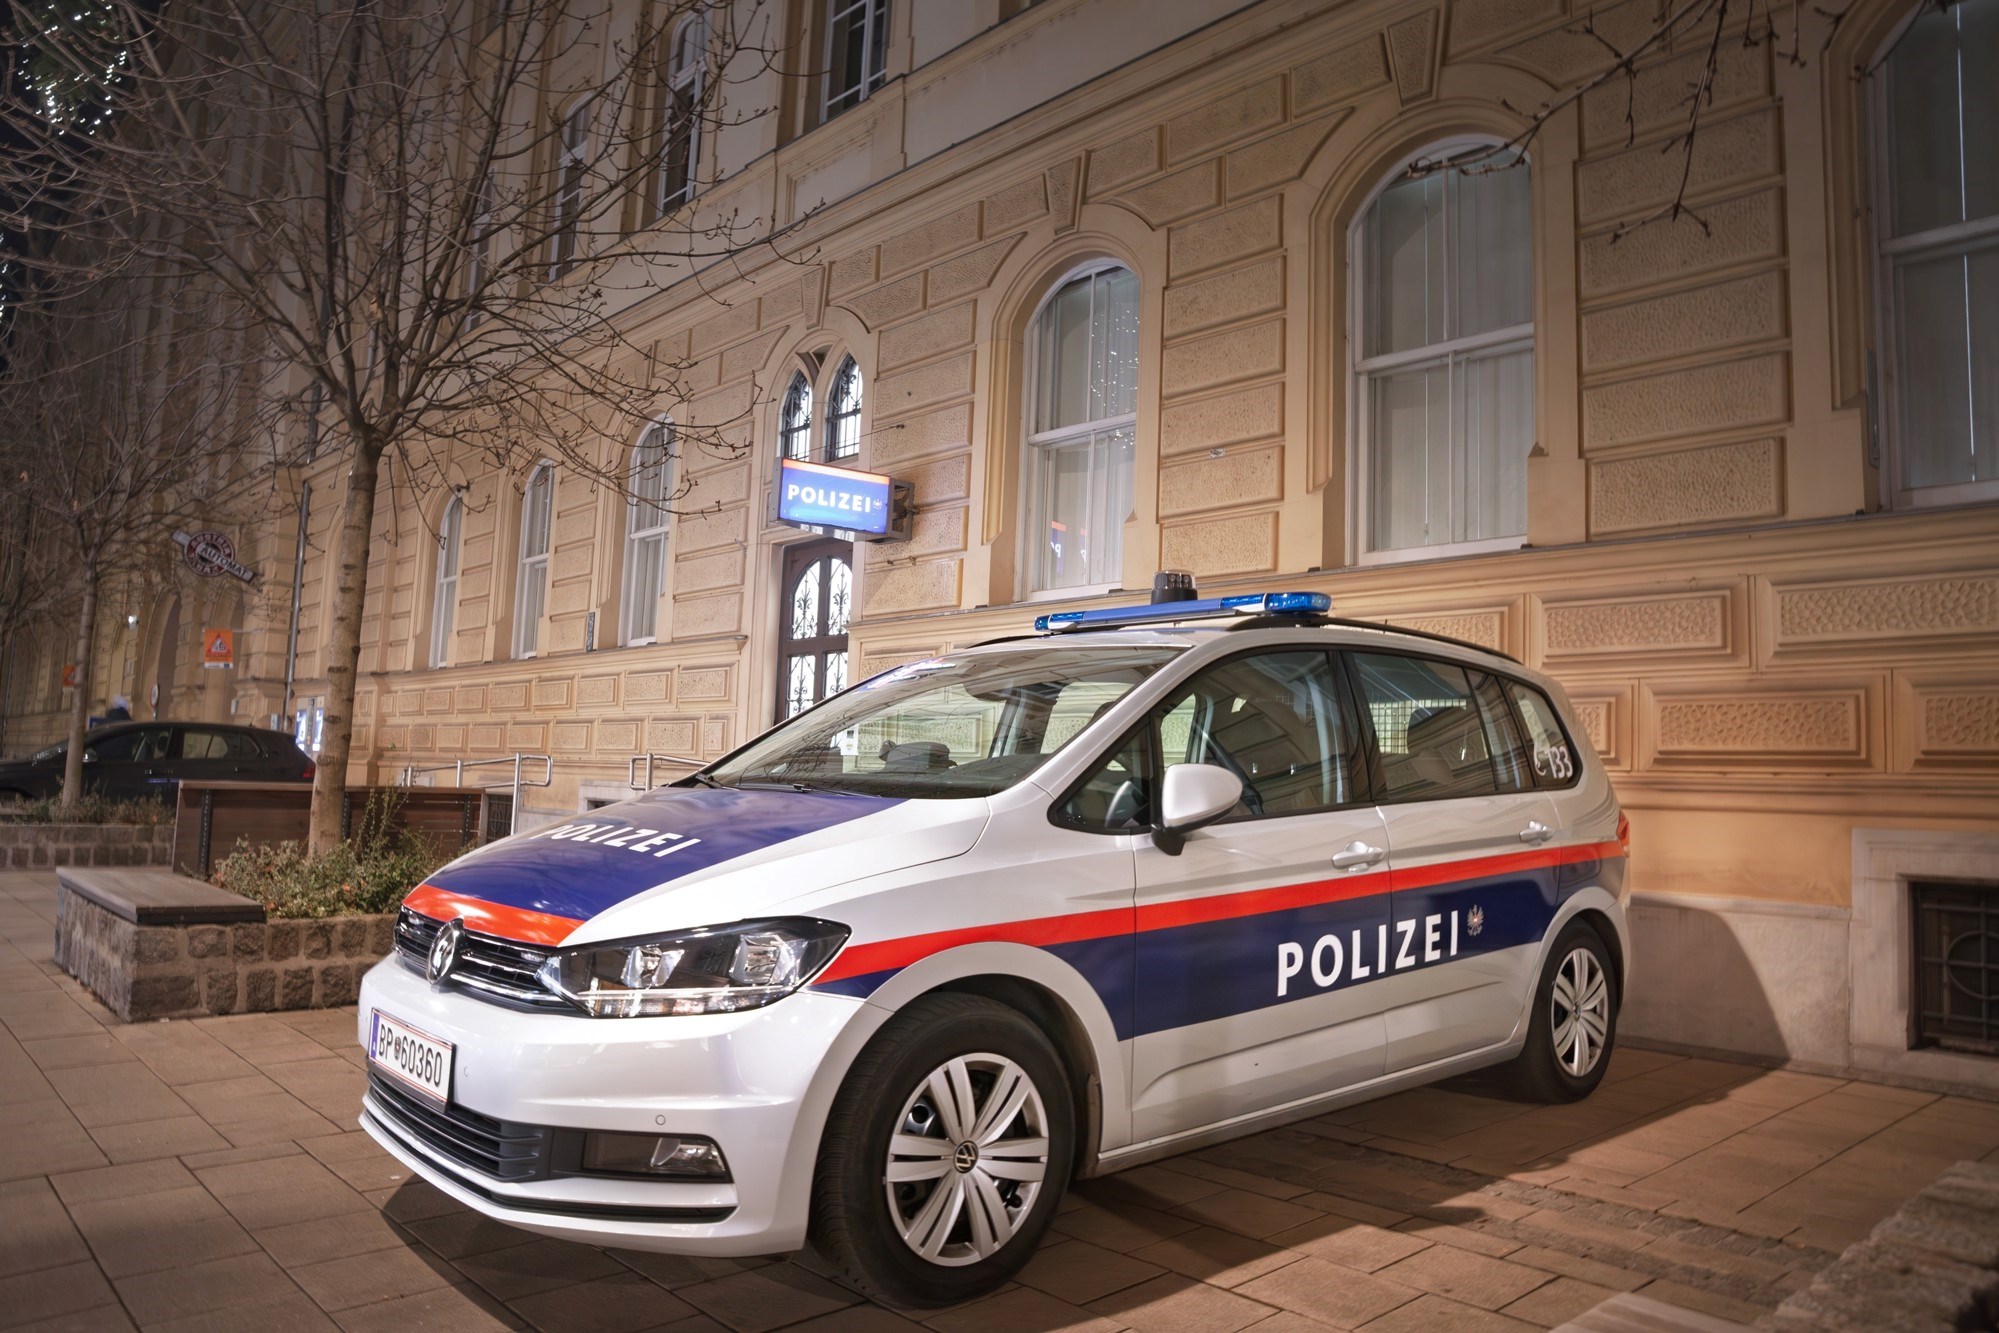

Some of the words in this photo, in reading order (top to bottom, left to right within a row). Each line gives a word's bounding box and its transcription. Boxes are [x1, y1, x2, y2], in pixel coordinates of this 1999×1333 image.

[788, 484, 871, 513] POLIZEI
[200, 547, 249, 577] AUTOMAT
[528, 823, 702, 858] POLIZEI
[1277, 909, 1459, 997] POLIZEI
[379, 1023, 394, 1060] BP
[400, 1035, 443, 1088] 60360
